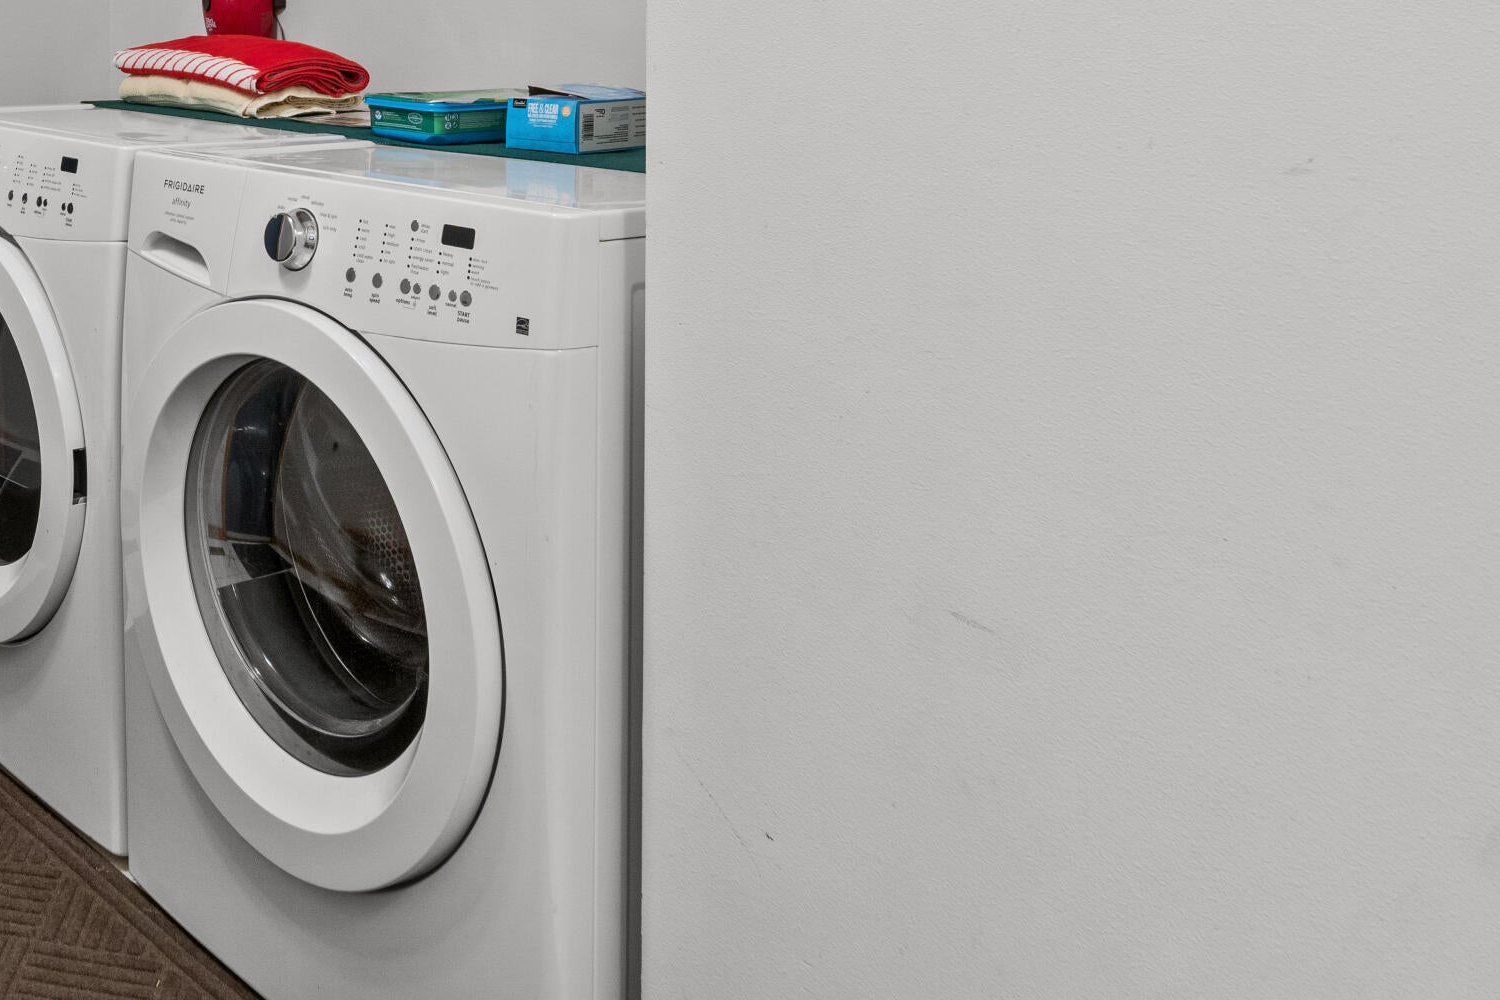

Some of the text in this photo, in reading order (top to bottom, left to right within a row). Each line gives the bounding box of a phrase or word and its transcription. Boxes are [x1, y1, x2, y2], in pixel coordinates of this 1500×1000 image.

[528, 102, 539, 114] FREE
[544, 103, 559, 115] CLEAR
[163, 179, 205, 195] FRIGIDAIRE
